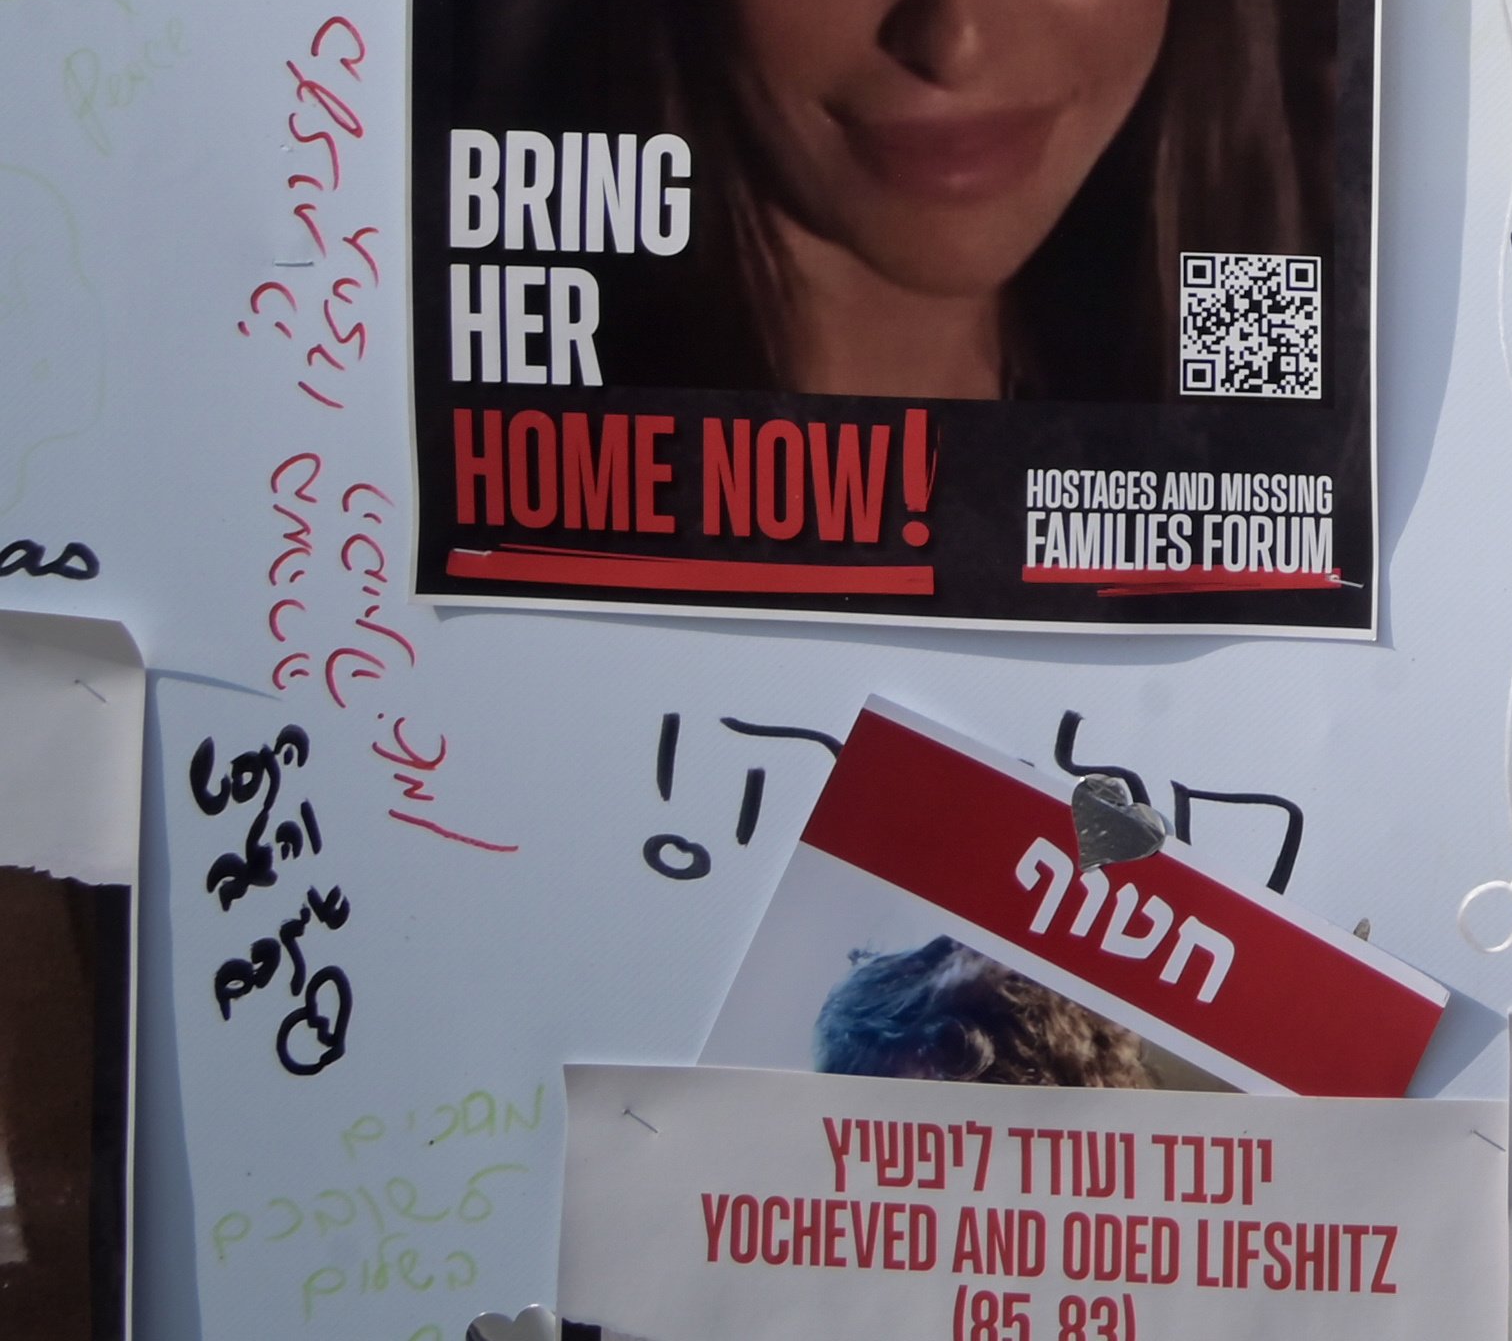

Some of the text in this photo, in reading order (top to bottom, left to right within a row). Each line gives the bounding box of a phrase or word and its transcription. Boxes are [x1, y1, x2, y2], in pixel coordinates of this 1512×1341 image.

[450, 129, 691, 256] BRING
[450, 264, 603, 386] HER
[454, 408, 938, 547] HOME NOW!
[1014, 835, 1236, 1005] חטוף
[826, 1119, 1273, 1205] יוכבד ועודד ליפשיץ
[704, 1195, 1399, 1294] YOCHEVED AND ODED LIFSHITZ
[1057, 1293, 1136, 1341] 83)
